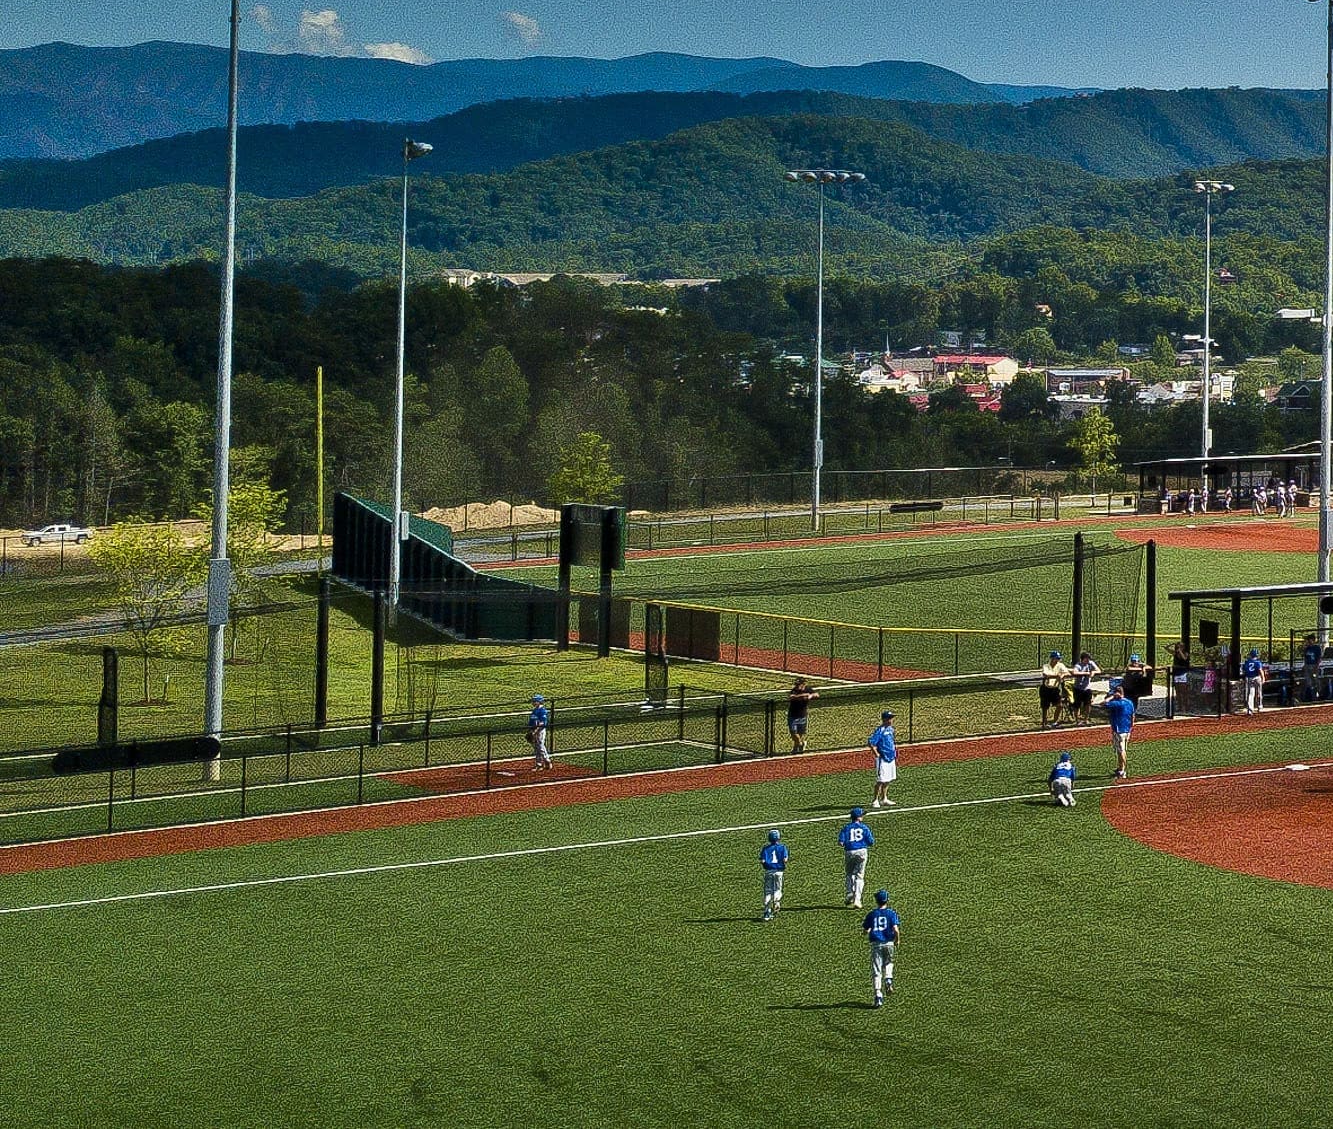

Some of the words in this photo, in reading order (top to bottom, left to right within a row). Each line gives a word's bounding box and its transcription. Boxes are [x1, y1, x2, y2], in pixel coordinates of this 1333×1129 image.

[1248, 662, 1256, 672] 2
[771, 850, 778, 864] 1
[872, 916, 887, 932] 19
